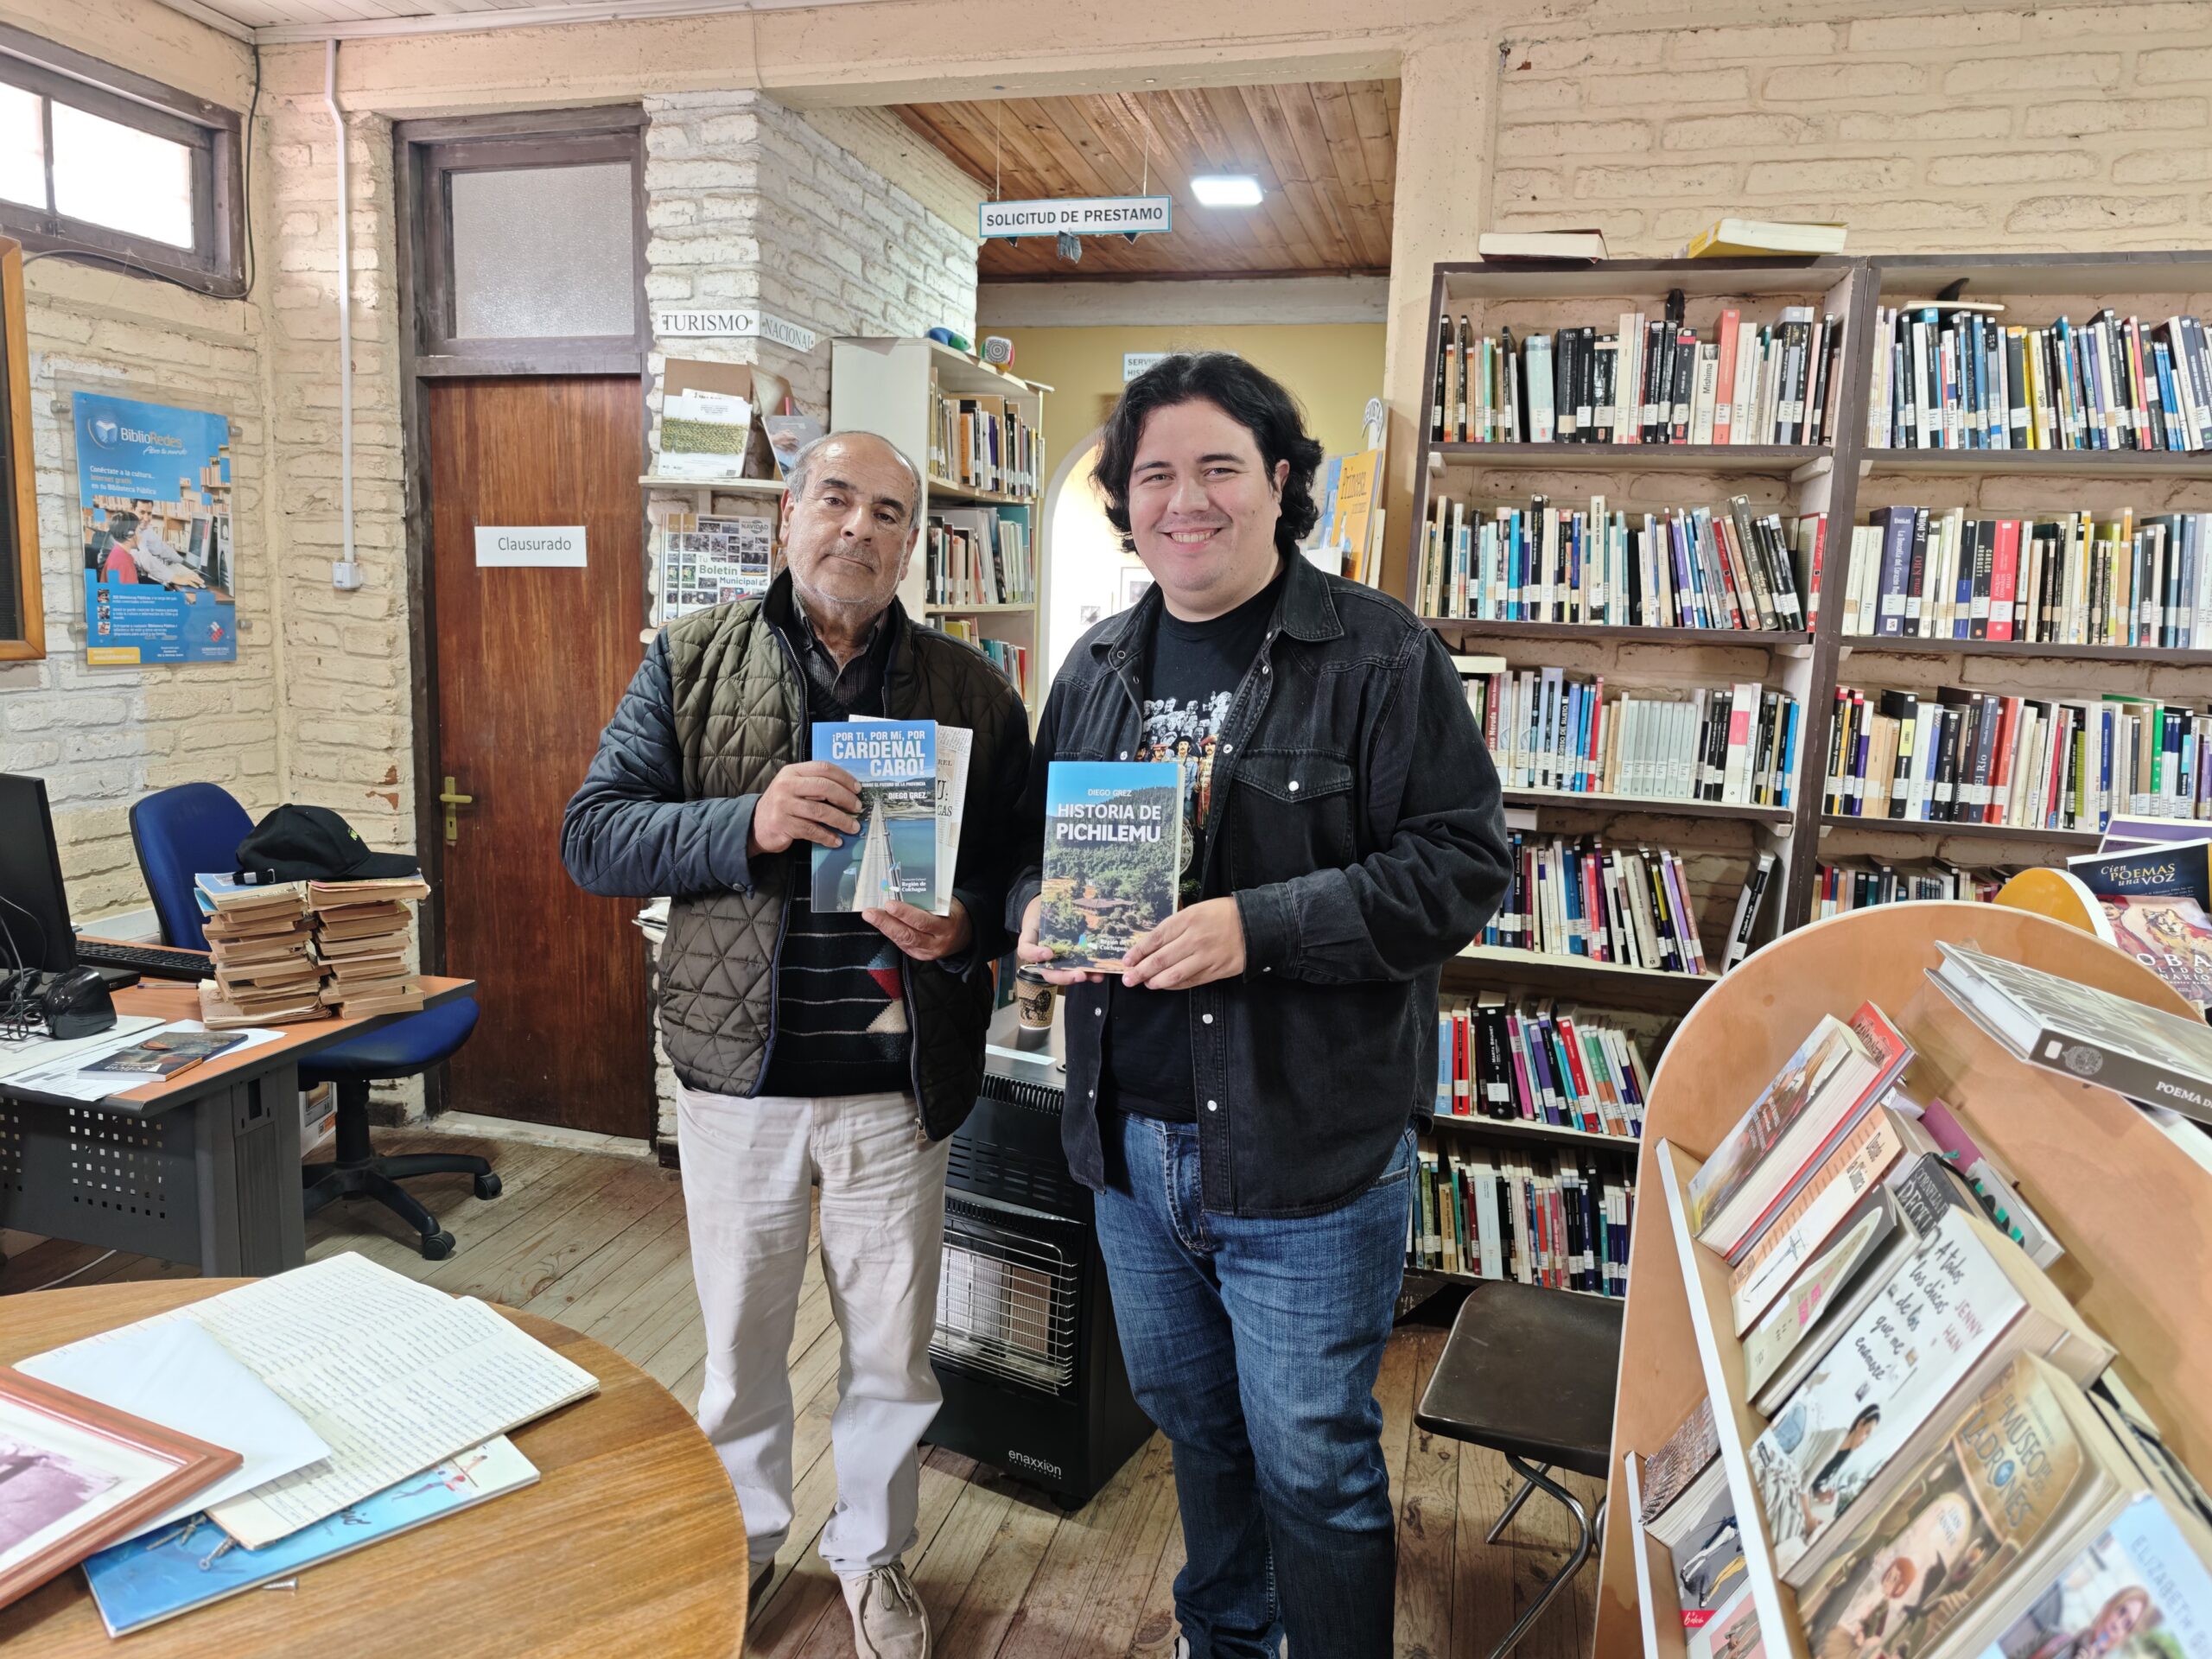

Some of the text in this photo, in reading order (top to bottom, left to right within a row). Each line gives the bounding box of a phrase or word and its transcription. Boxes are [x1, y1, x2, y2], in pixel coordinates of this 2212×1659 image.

[986, 207, 1163, 226] SOLICITUD DE PRESTAMO
[662, 315, 749, 331] TURISMO
[765, 318, 814, 351] NACIONAL
[1702, 363, 1713, 394] Mishima
[120, 427, 183, 448] BiblioRedes
[89, 465, 118, 475] Conéctate
[498, 536, 573, 553] Clausurado
[1897, 530, 1906, 539] La
[1896, 537, 1905, 558] Doncella
[1895, 558, 1904, 567] del
[1912, 556, 1923, 575] KBO
[1984, 549, 1993, 573] CARLOS
[719, 576, 758, 587] Municipal
[1489, 712, 1497, 736] Neruda
[856, 732, 868, 743] TI,
[870, 731, 888, 741] POR
[907, 730, 925, 741] POR
[832, 741, 926, 760] CARDENAL
[870, 759, 925, 777] CARO!
[1976, 754, 1987, 772] Río
[1974, 776, 1985, 788] El
[888, 791, 907, 800] DIEGO
[1088, 788, 1110, 797] DIEGO
[1057, 803, 1162, 821] HISTORIA DE
[1056, 823, 1162, 843] PICHILEMU
[2101, 865, 2126, 875] Cien
[2110, 863, 2176, 881] POEMAS
[2119, 873, 2176, 887] una VOZ
[2155, 1080, 2202, 1105] POEMA
[1866, 1132, 1885, 1163] Desde
[1914, 1166, 1944, 1210] CORNELIA
[1935, 1240, 1955, 1262] A
[1910, 1260, 1949, 1315] los chicos
[1895, 1293, 1924, 1332] de los
[1955, 1299, 1985, 1339] JENNY
[1870, 1315, 1905, 1356] que me
[1942, 1323, 1963, 1354] HAN
[1855, 1337, 1891, 1381] enamoré
[1999, 1407, 2048, 1479] MUSEO
[1008, 1450, 1062, 1477] enaxxion
[1962, 1409, 2033, 1529] LADRONES
[2131, 1534, 2193, 1630] ELIZABETH
